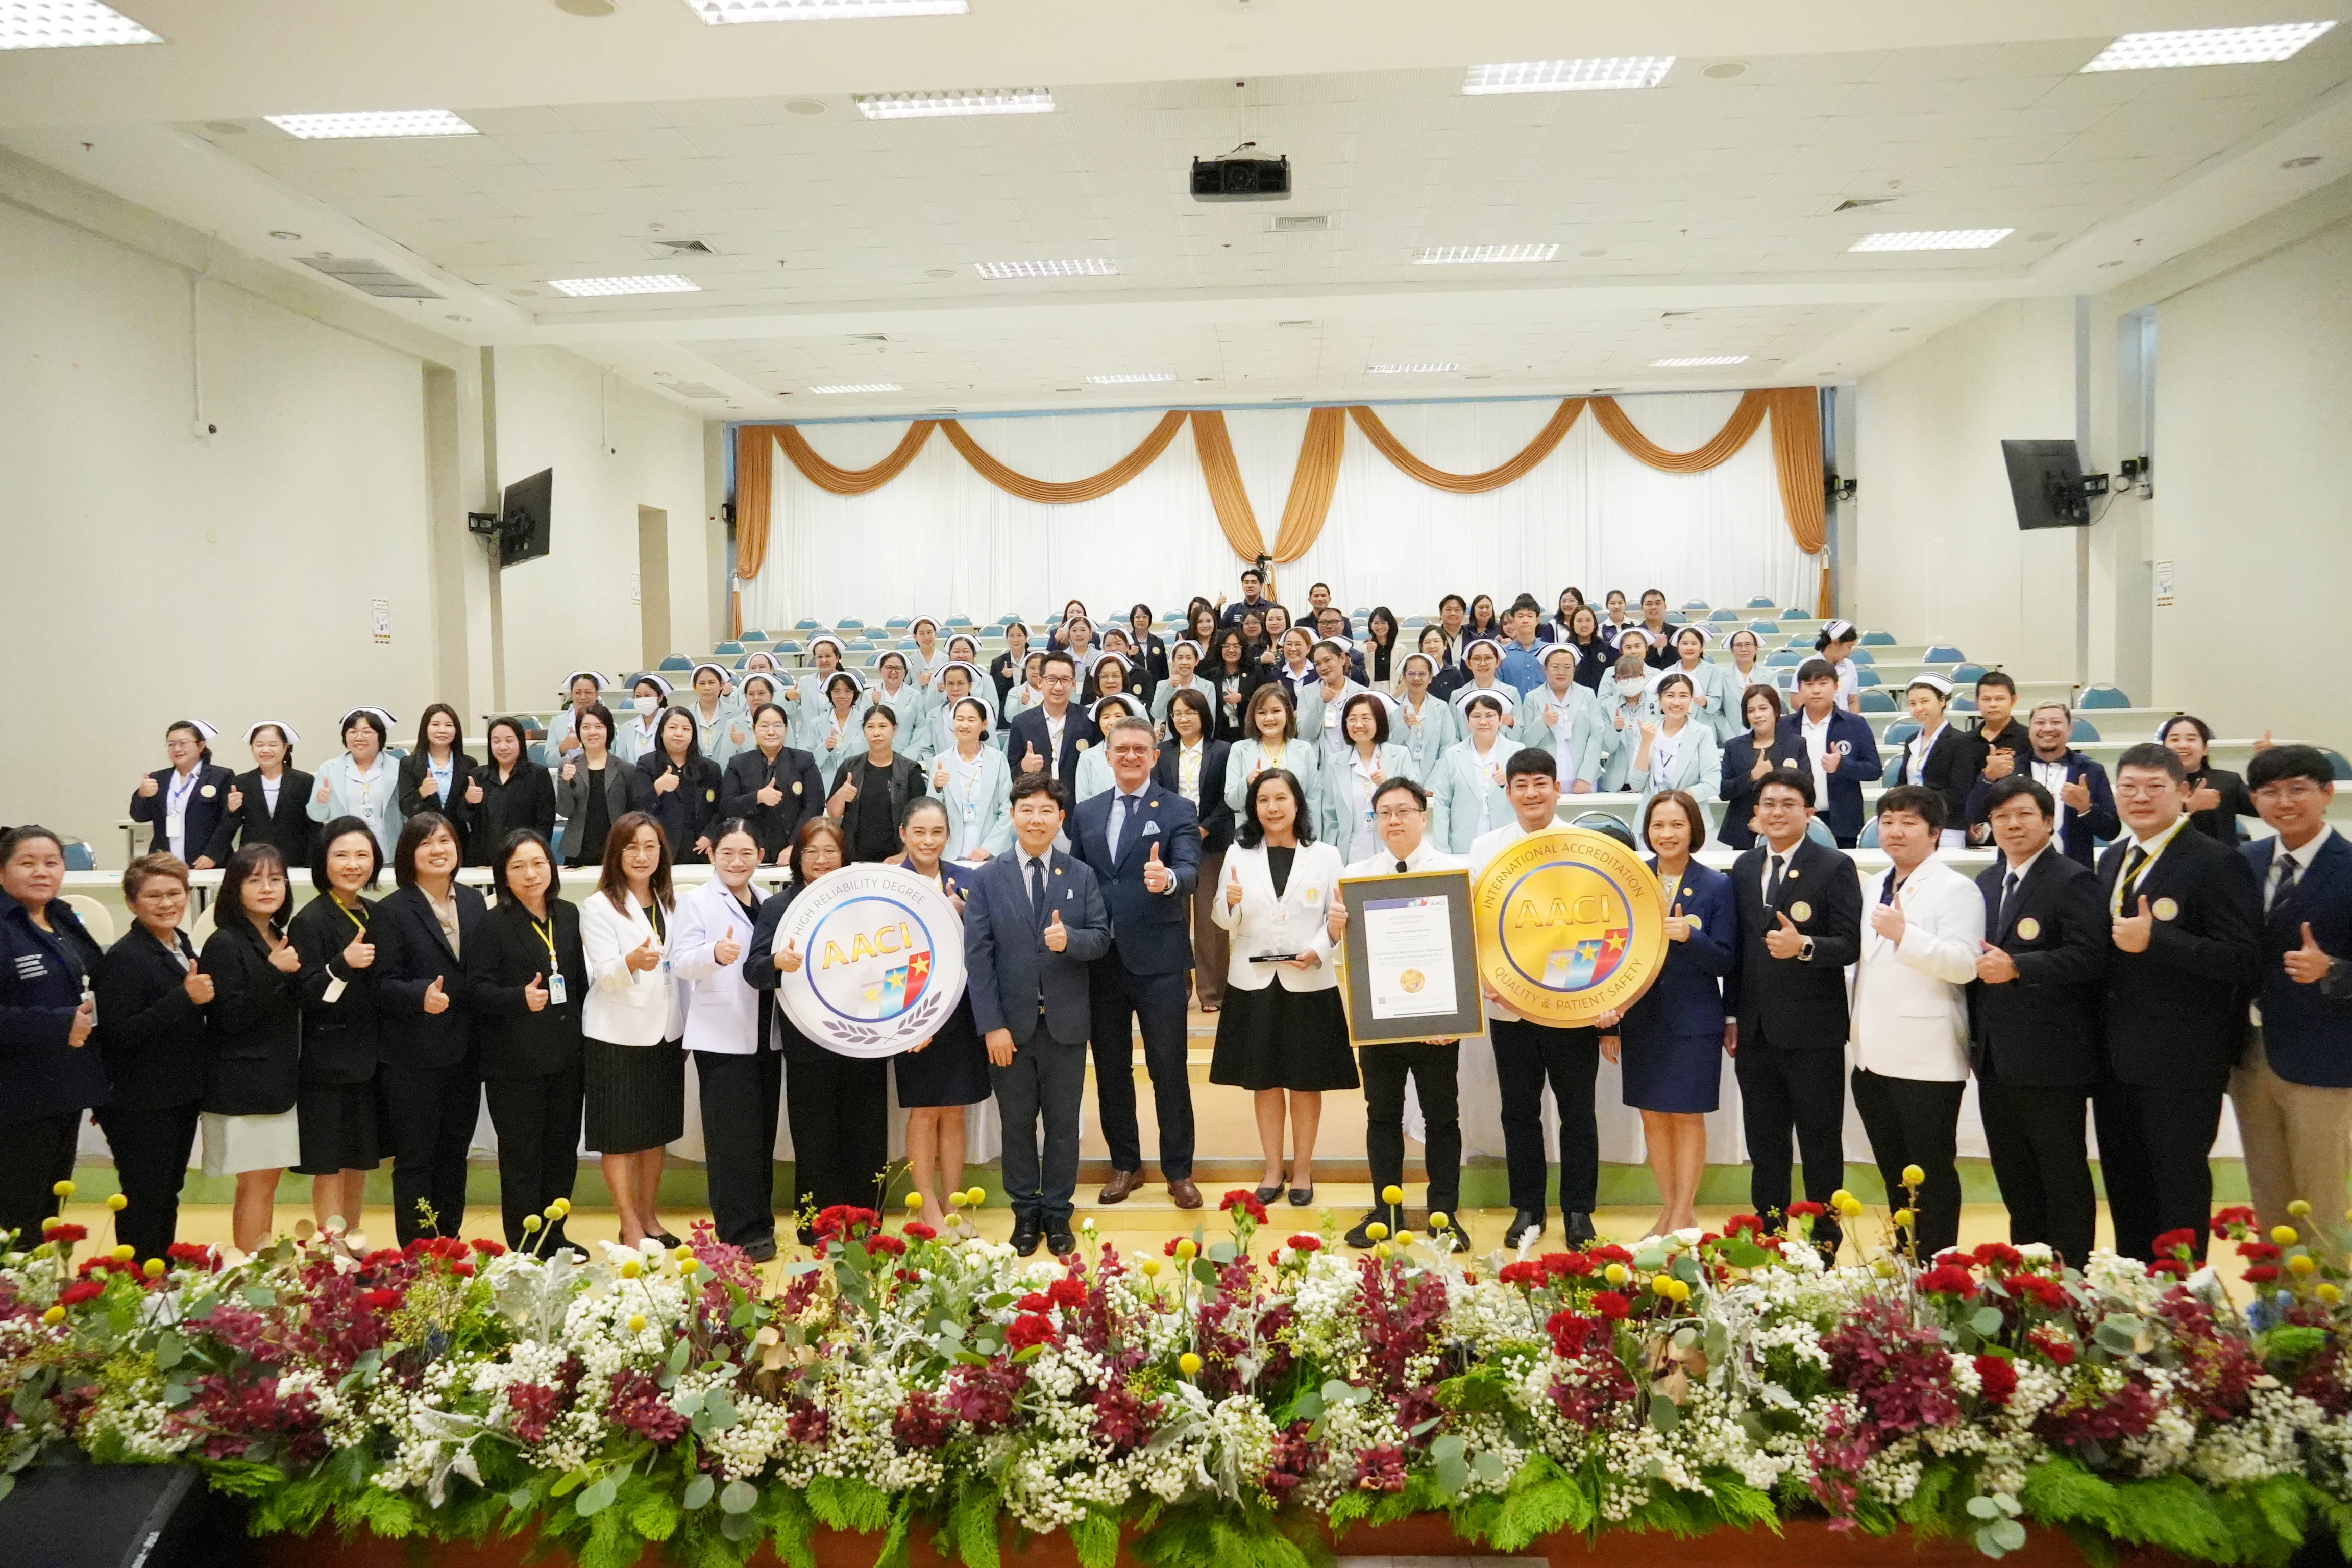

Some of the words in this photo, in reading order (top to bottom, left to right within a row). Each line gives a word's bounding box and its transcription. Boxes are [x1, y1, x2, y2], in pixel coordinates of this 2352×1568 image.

[1483, 843, 1558, 909] INTERNATIONAL
[1562, 843, 1645, 898] ACCREDITATION
[794, 909, 815, 936] HIGH
[814, 878, 877, 908] RELIABILITY
[883, 879, 926, 905] DEGREE
[1515, 895, 1610, 928] AACI
[822, 922, 912, 969] AACI
[1494, 967, 1540, 1003] QUALITY
[1541, 998, 1552, 1009] &
[1556, 992, 1606, 1011] PATIENT
[1607, 958, 1643, 997] SAFETY
